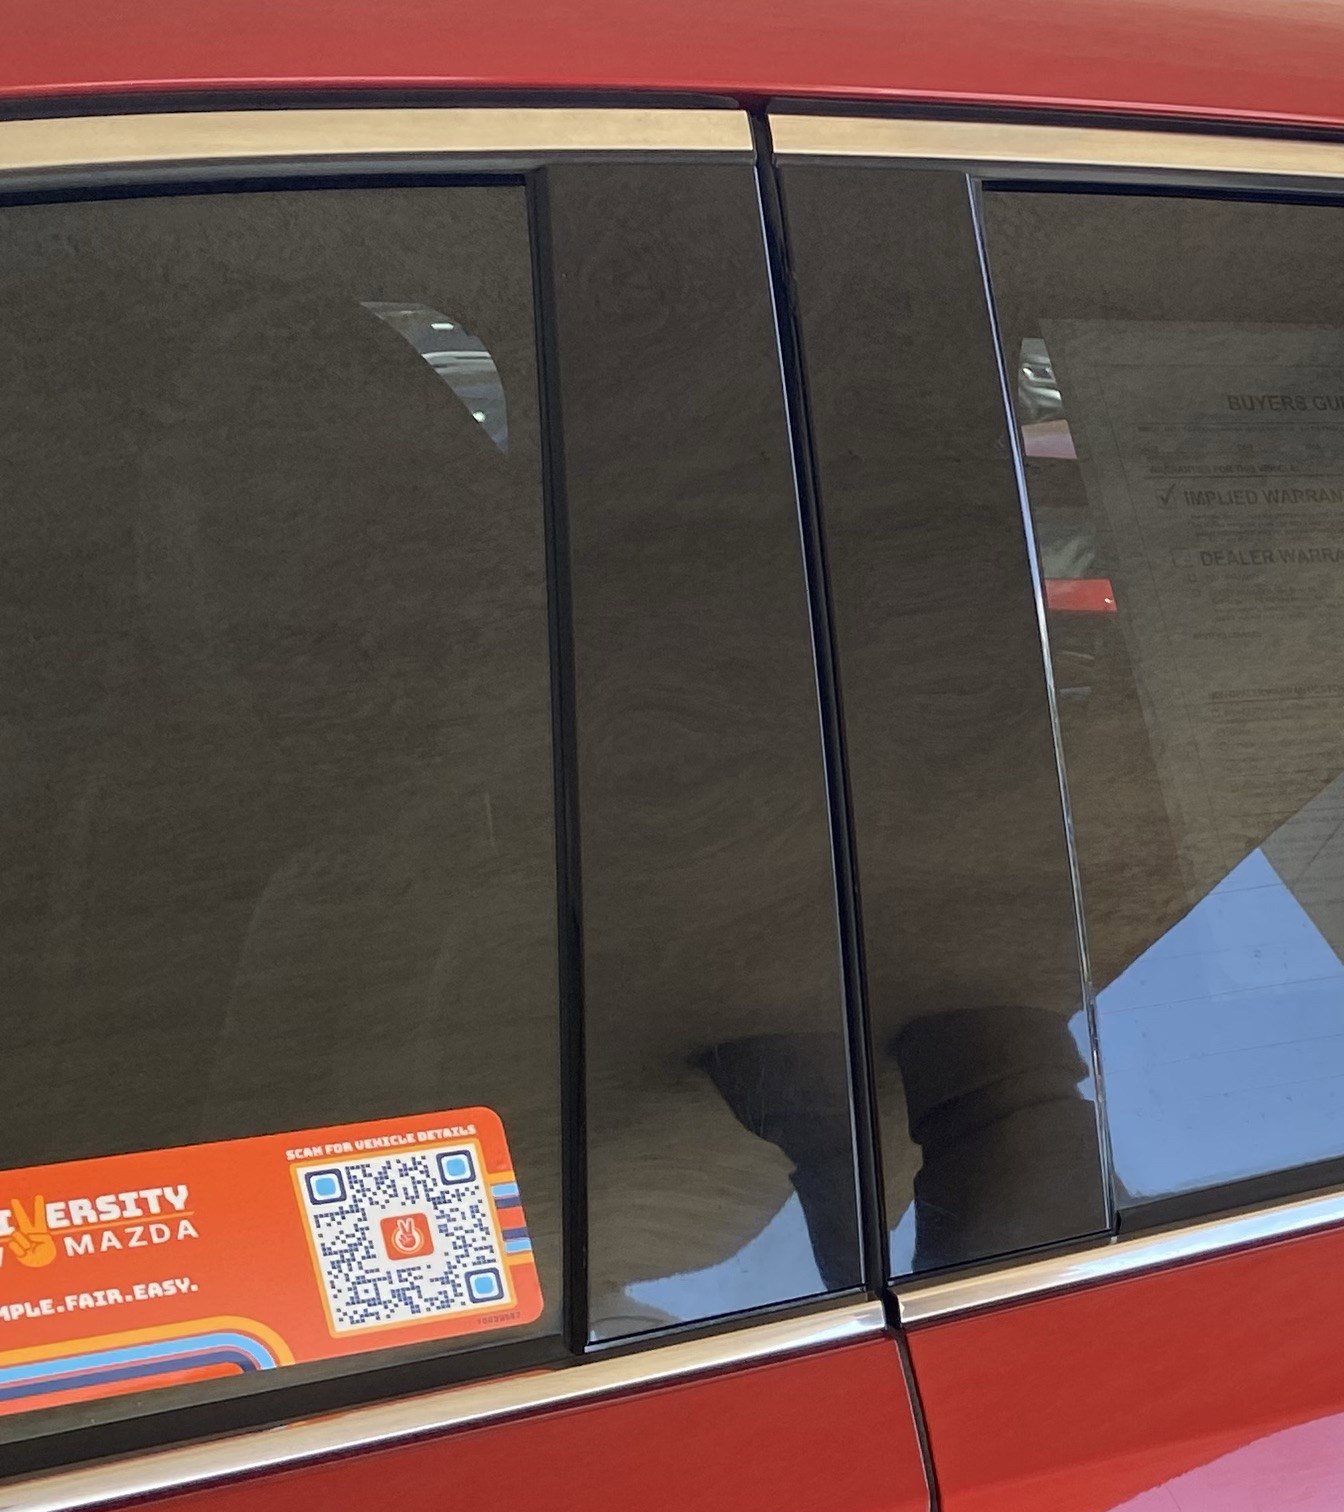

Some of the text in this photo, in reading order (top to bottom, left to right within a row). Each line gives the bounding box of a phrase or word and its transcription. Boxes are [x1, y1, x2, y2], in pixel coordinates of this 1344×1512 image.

[1227, 394, 1308, 412] BUYERS
[1184, 489, 1259, 507] IMPLIED
[1200, 549, 1275, 567] DEALER
[285, 1124, 477, 1161] SCAN FOR VEHICLE DETAILS
[63, 1219, 199, 1257] MAZDA
